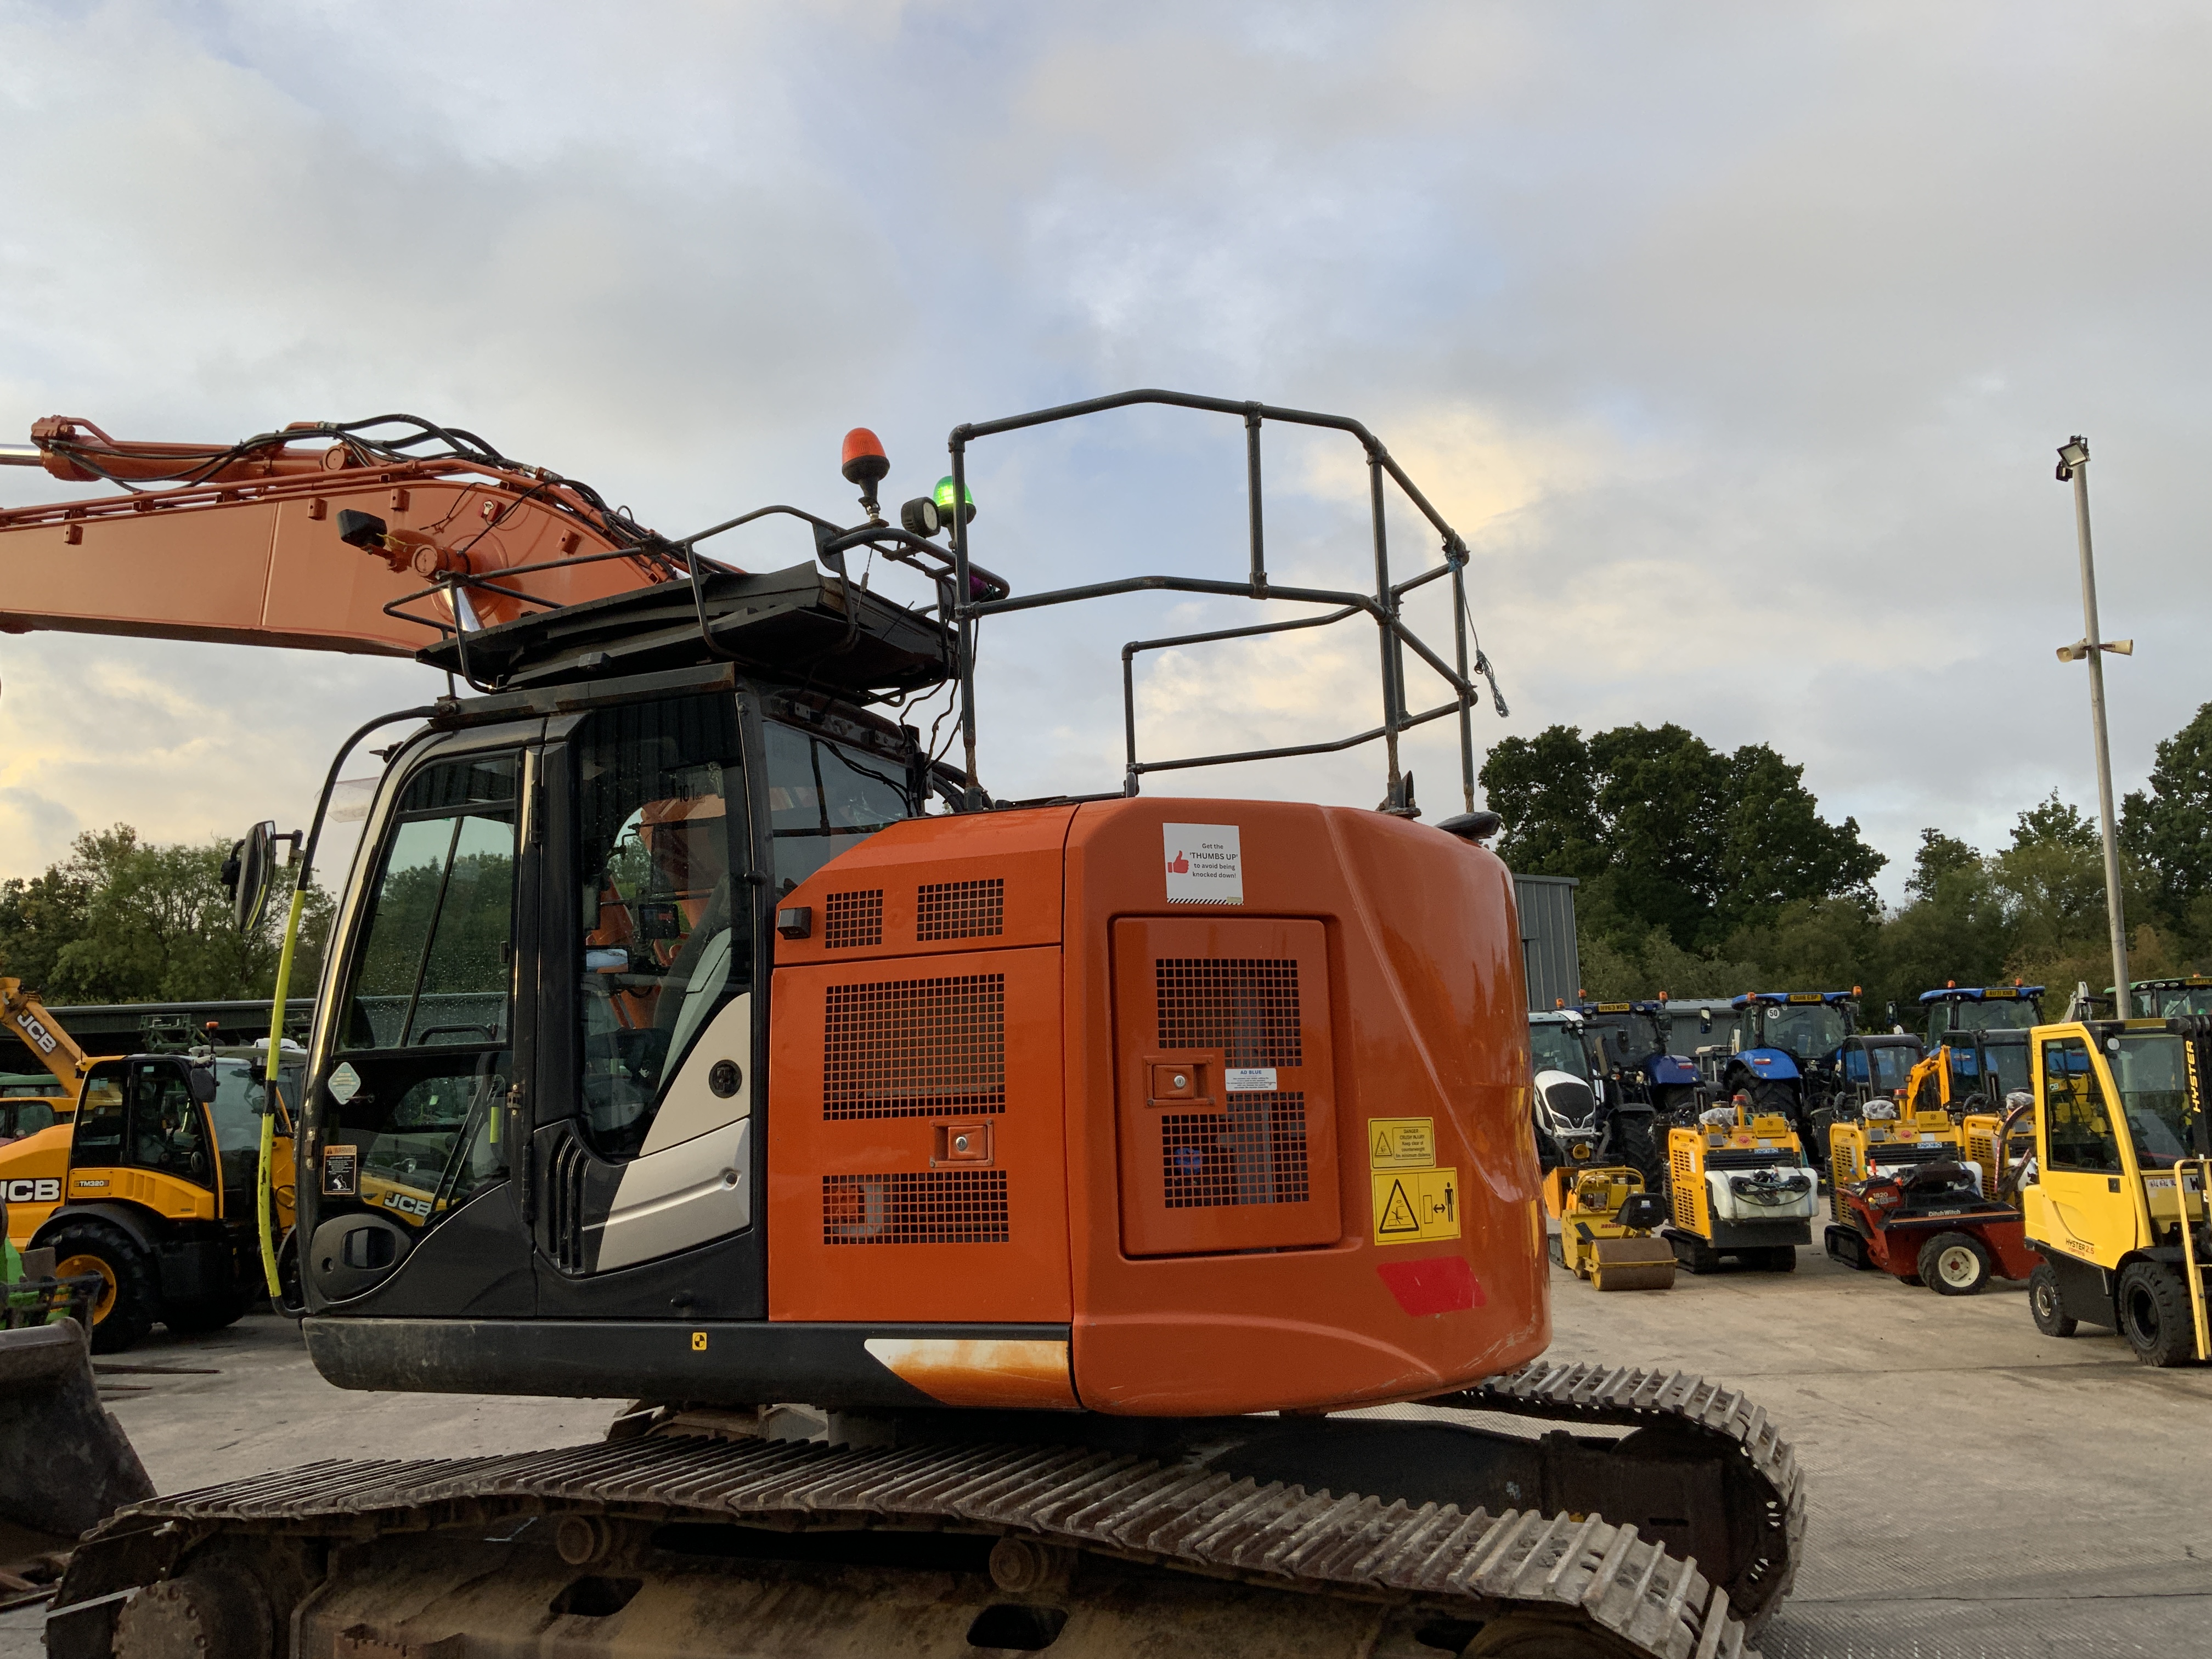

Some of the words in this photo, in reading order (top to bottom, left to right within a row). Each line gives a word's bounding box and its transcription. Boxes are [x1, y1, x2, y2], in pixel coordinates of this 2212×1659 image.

[16, 1013, 57, 1053] JCB
[2185, 1040, 2201, 1113] HYSTER
[2066, 1238, 2085, 1251] HYSTER
[2085, 1245, 2095, 1255] 2.5
